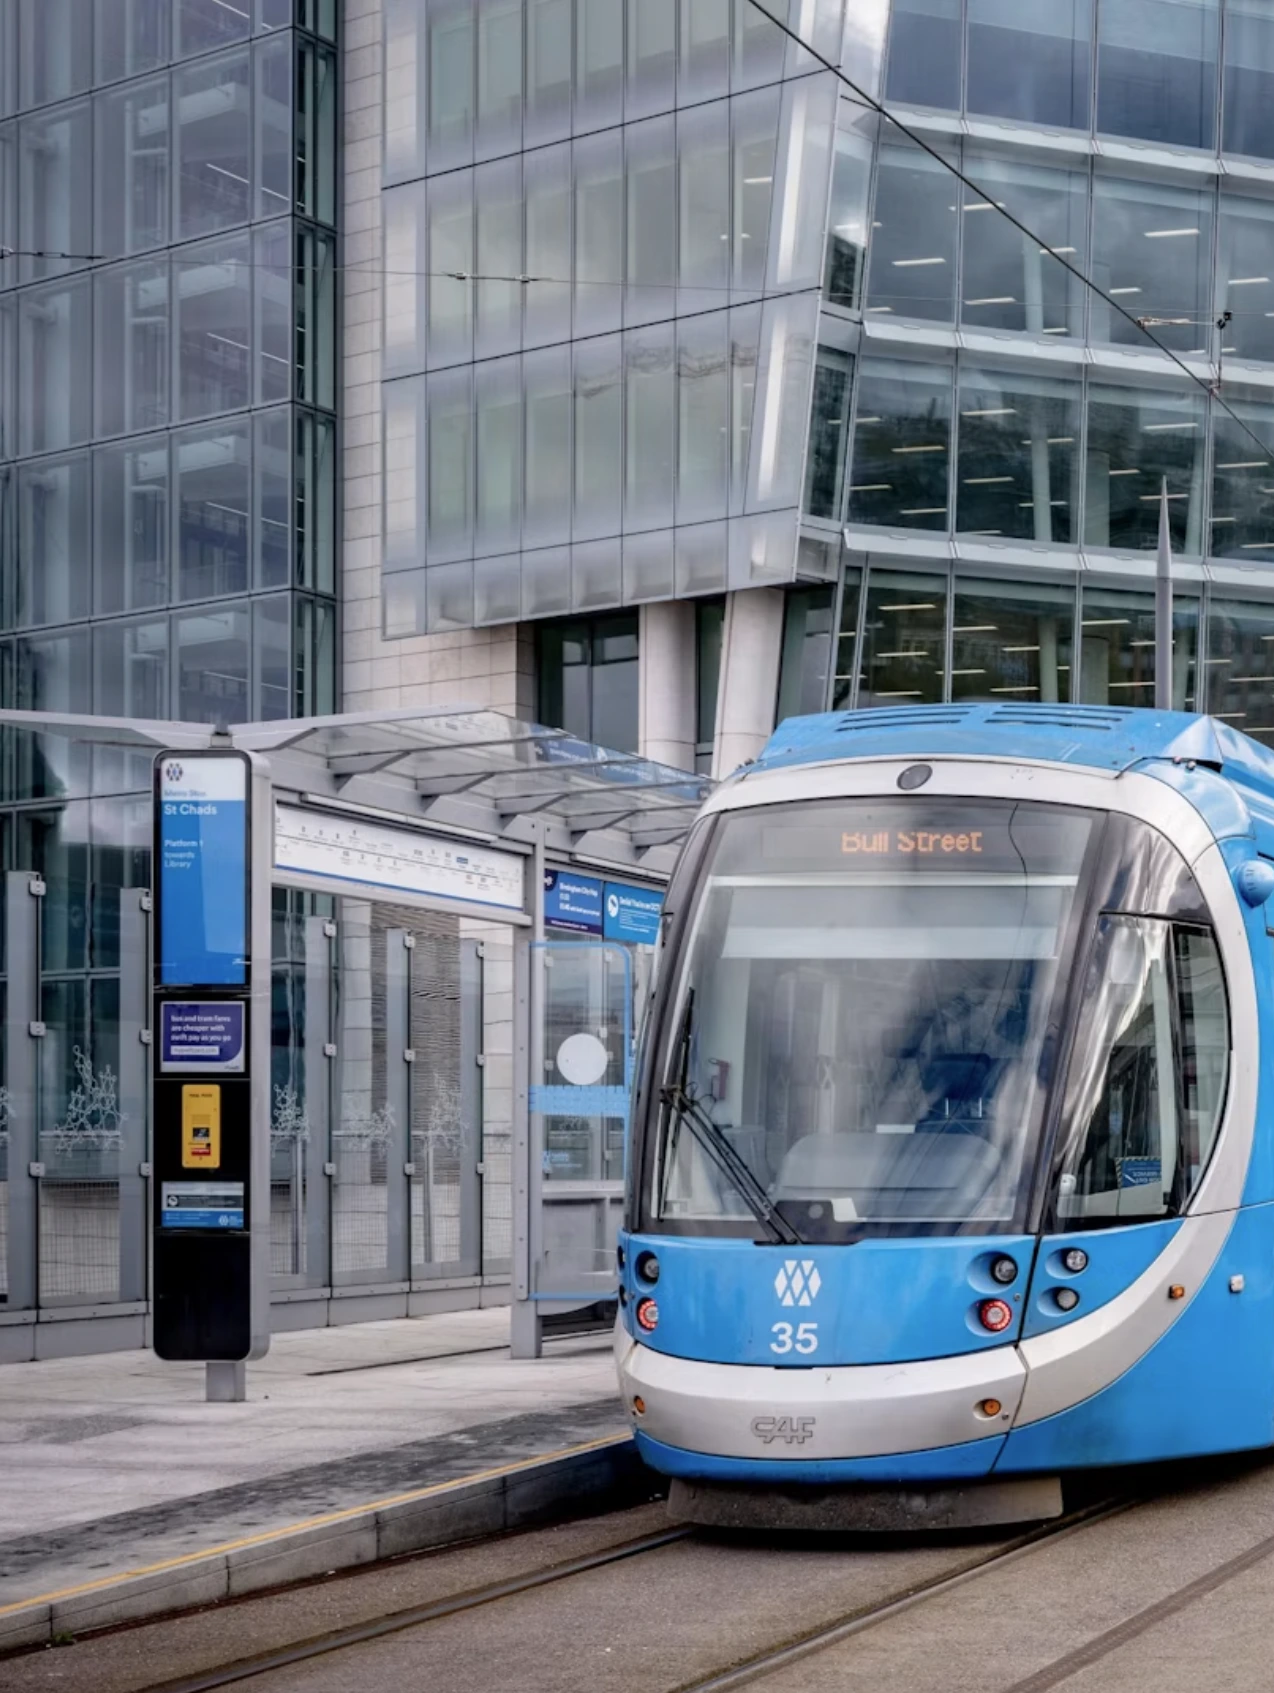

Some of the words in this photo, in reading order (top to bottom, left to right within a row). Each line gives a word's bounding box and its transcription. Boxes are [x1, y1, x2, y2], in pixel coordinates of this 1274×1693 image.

[164, 803, 177, 816] St
[179, 803, 218, 816] Chads
[164, 839, 198, 848] Platform
[841, 831, 889, 852] Bull
[897, 831, 982, 852] Street
[164, 851, 195, 859] towards
[164, 860, 192, 869] Library
[182, 1024, 209, 1033] cheaper
[170, 1033, 188, 1041] swift
[769, 1322, 819, 1355] 35
